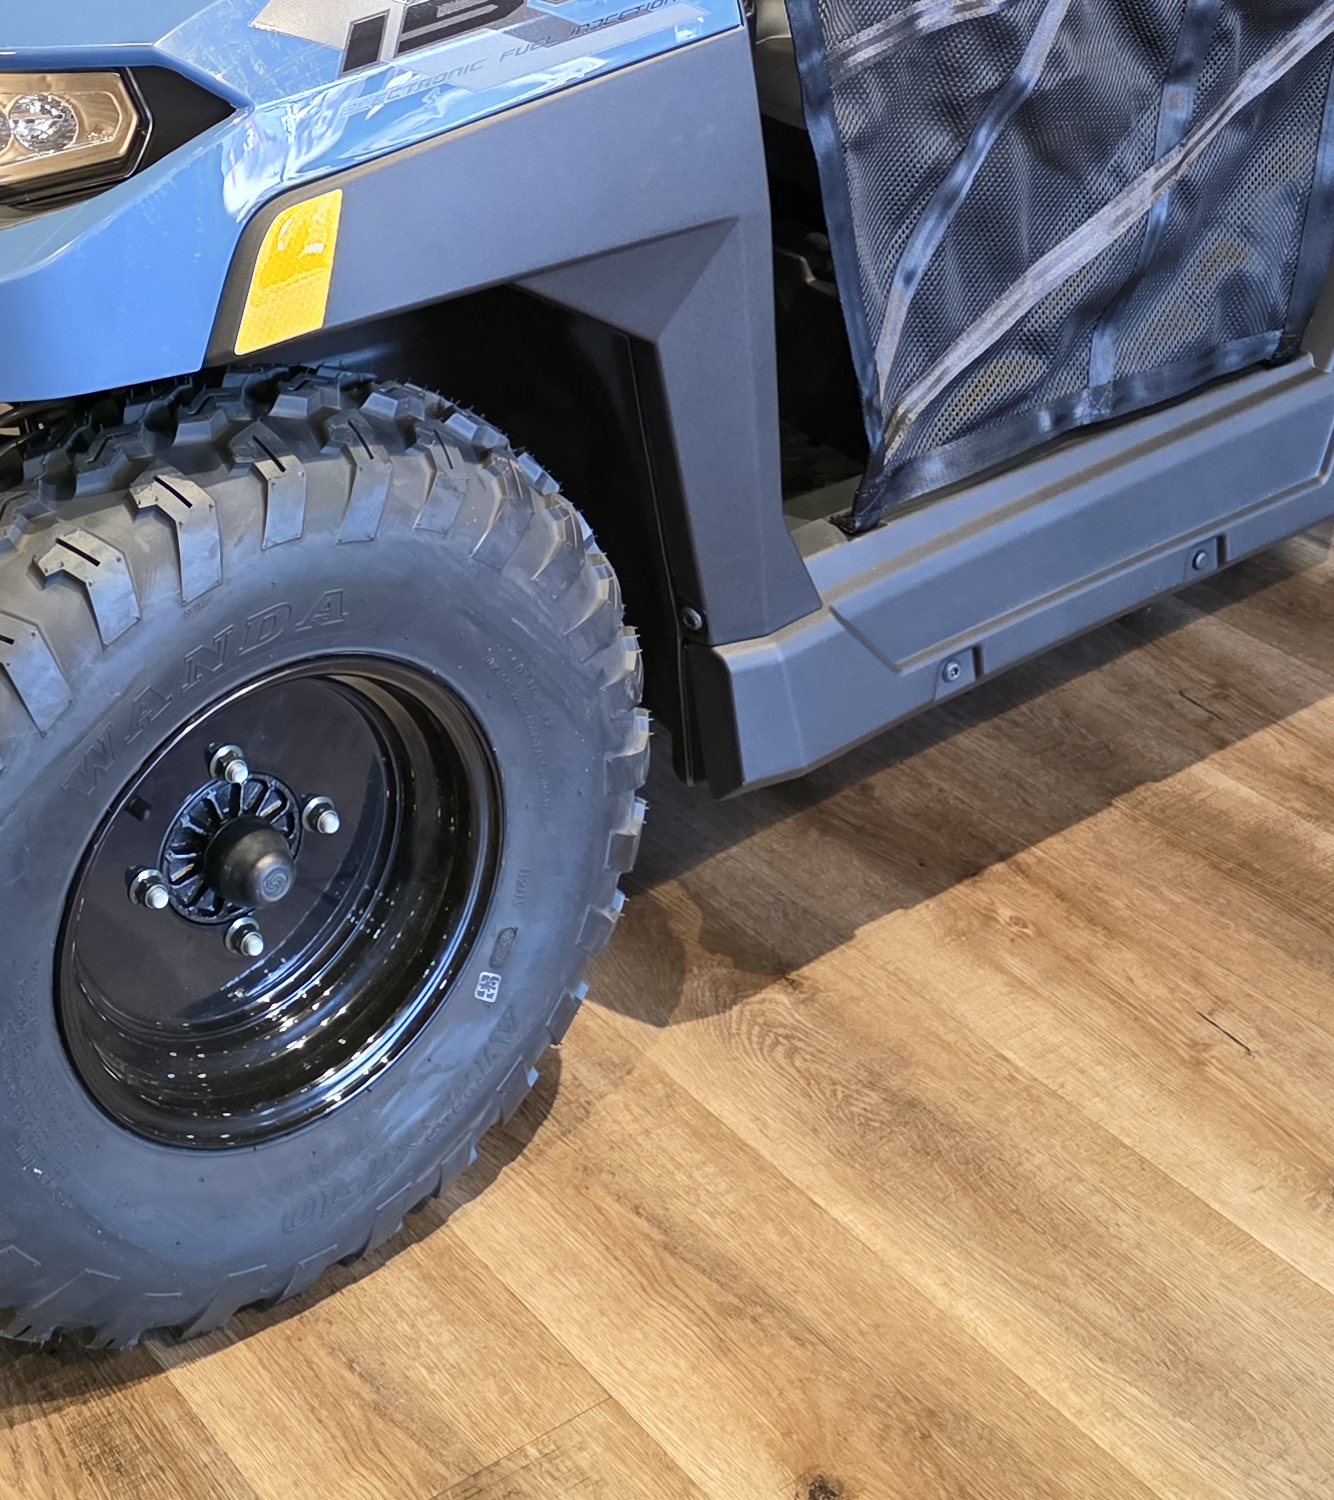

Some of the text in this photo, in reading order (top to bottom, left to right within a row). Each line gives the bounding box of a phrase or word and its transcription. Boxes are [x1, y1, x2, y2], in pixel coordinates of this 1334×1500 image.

[338, 57, 485, 118] ELECTRONIC
[499, 34, 558, 64] FUEL
[60, 587, 350, 798] WANDA
